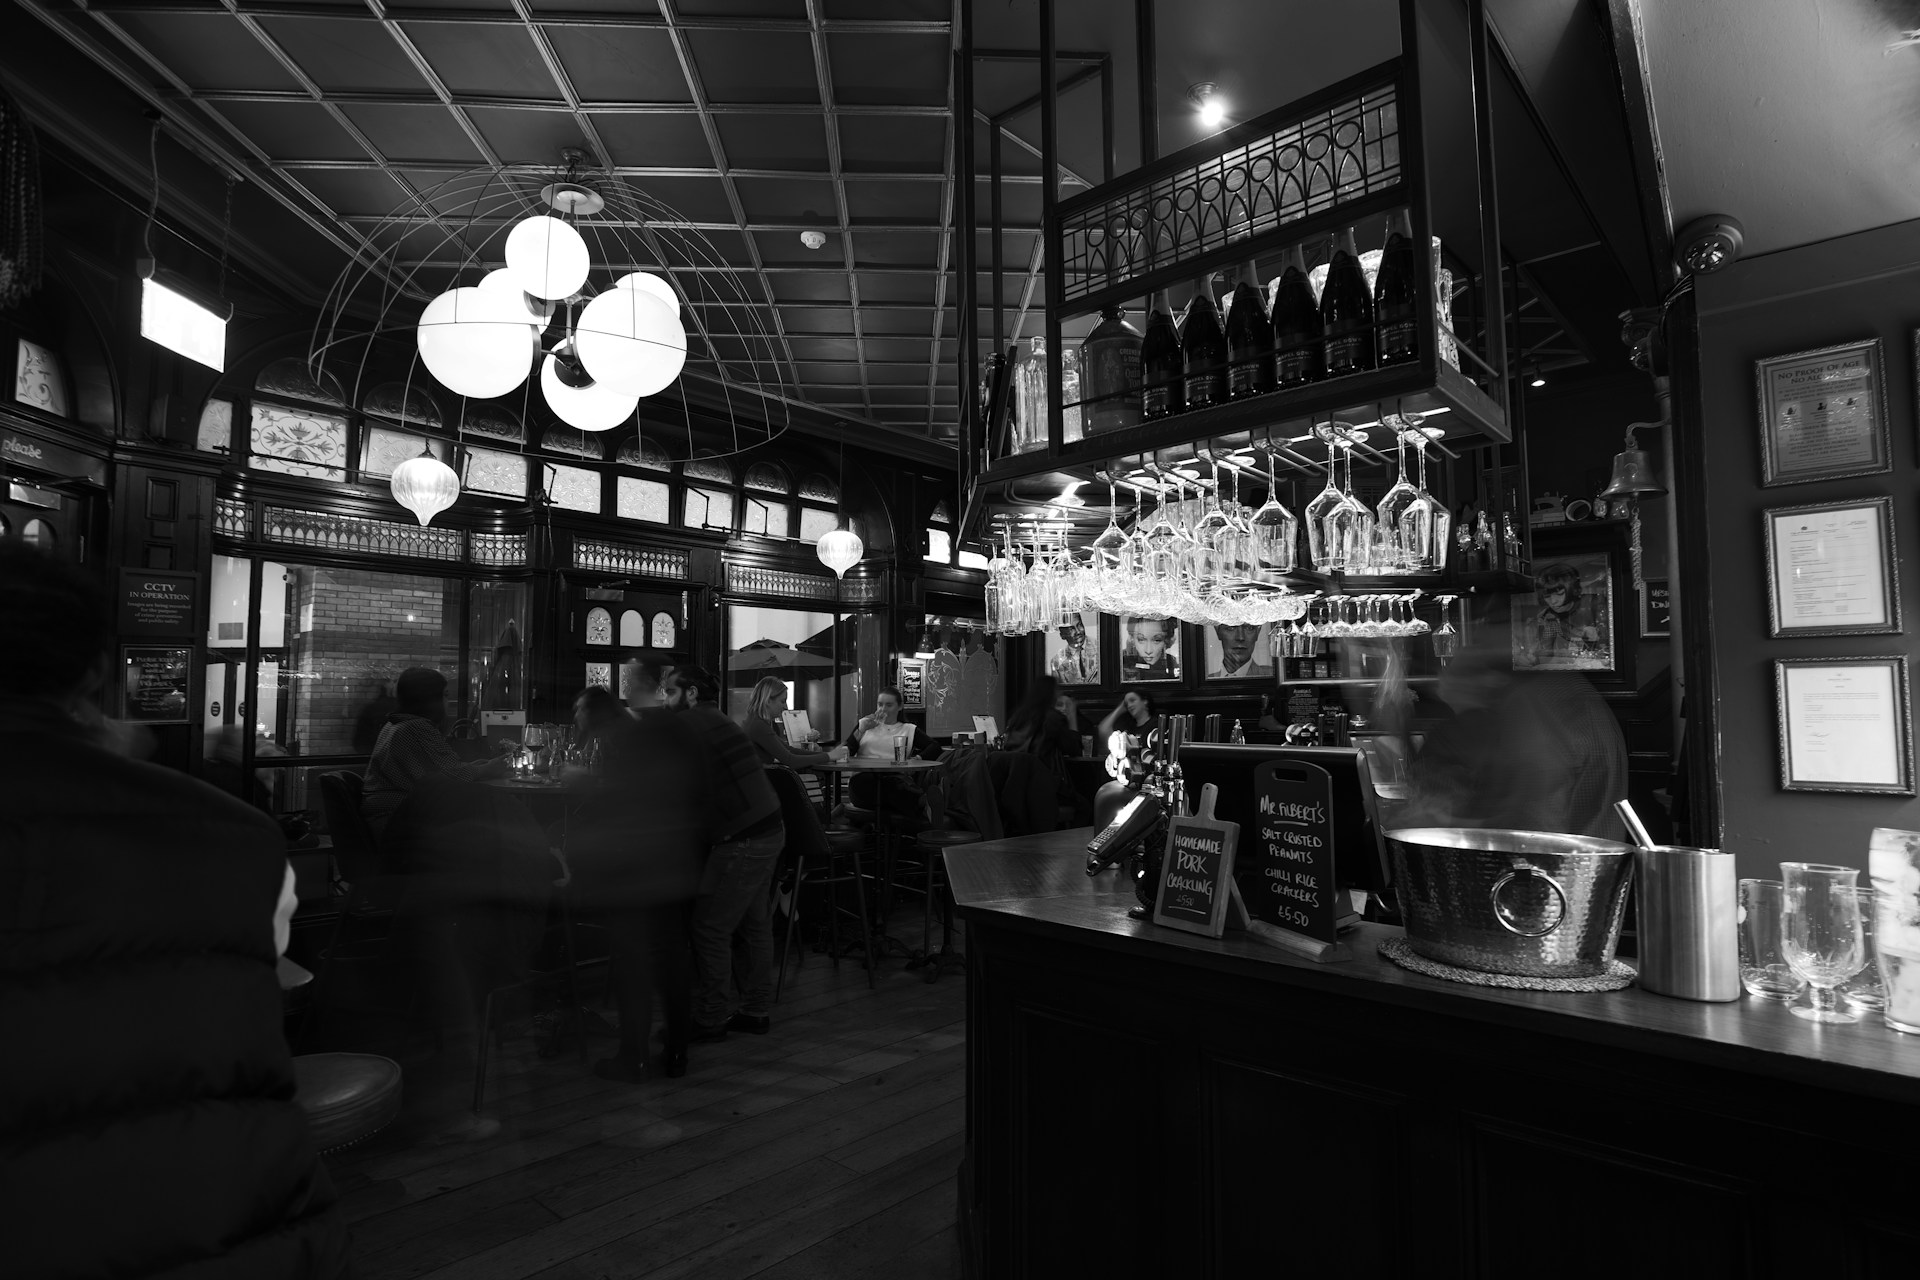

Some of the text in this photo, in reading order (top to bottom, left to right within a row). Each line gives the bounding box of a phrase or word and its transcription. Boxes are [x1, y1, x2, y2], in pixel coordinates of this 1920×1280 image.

[1842, 360, 1860, 369] AGE
[1, 436, 42, 460] please
[141, 591, 190, 601] OPERATION
[144, 582, 176, 592] CCTV
[1174, 834, 1222, 855] HOMEMADE
[1261, 827, 1322, 849] SALT CRUSTED
[1177, 849, 1209, 874] PORK
[1268, 843, 1314, 864] PEANUTS
[1166, 872, 1213, 904] CRACKLING
[1264, 867, 1320, 889] CHILLI RICE
[1270, 882, 1320, 909] CRACKERS
